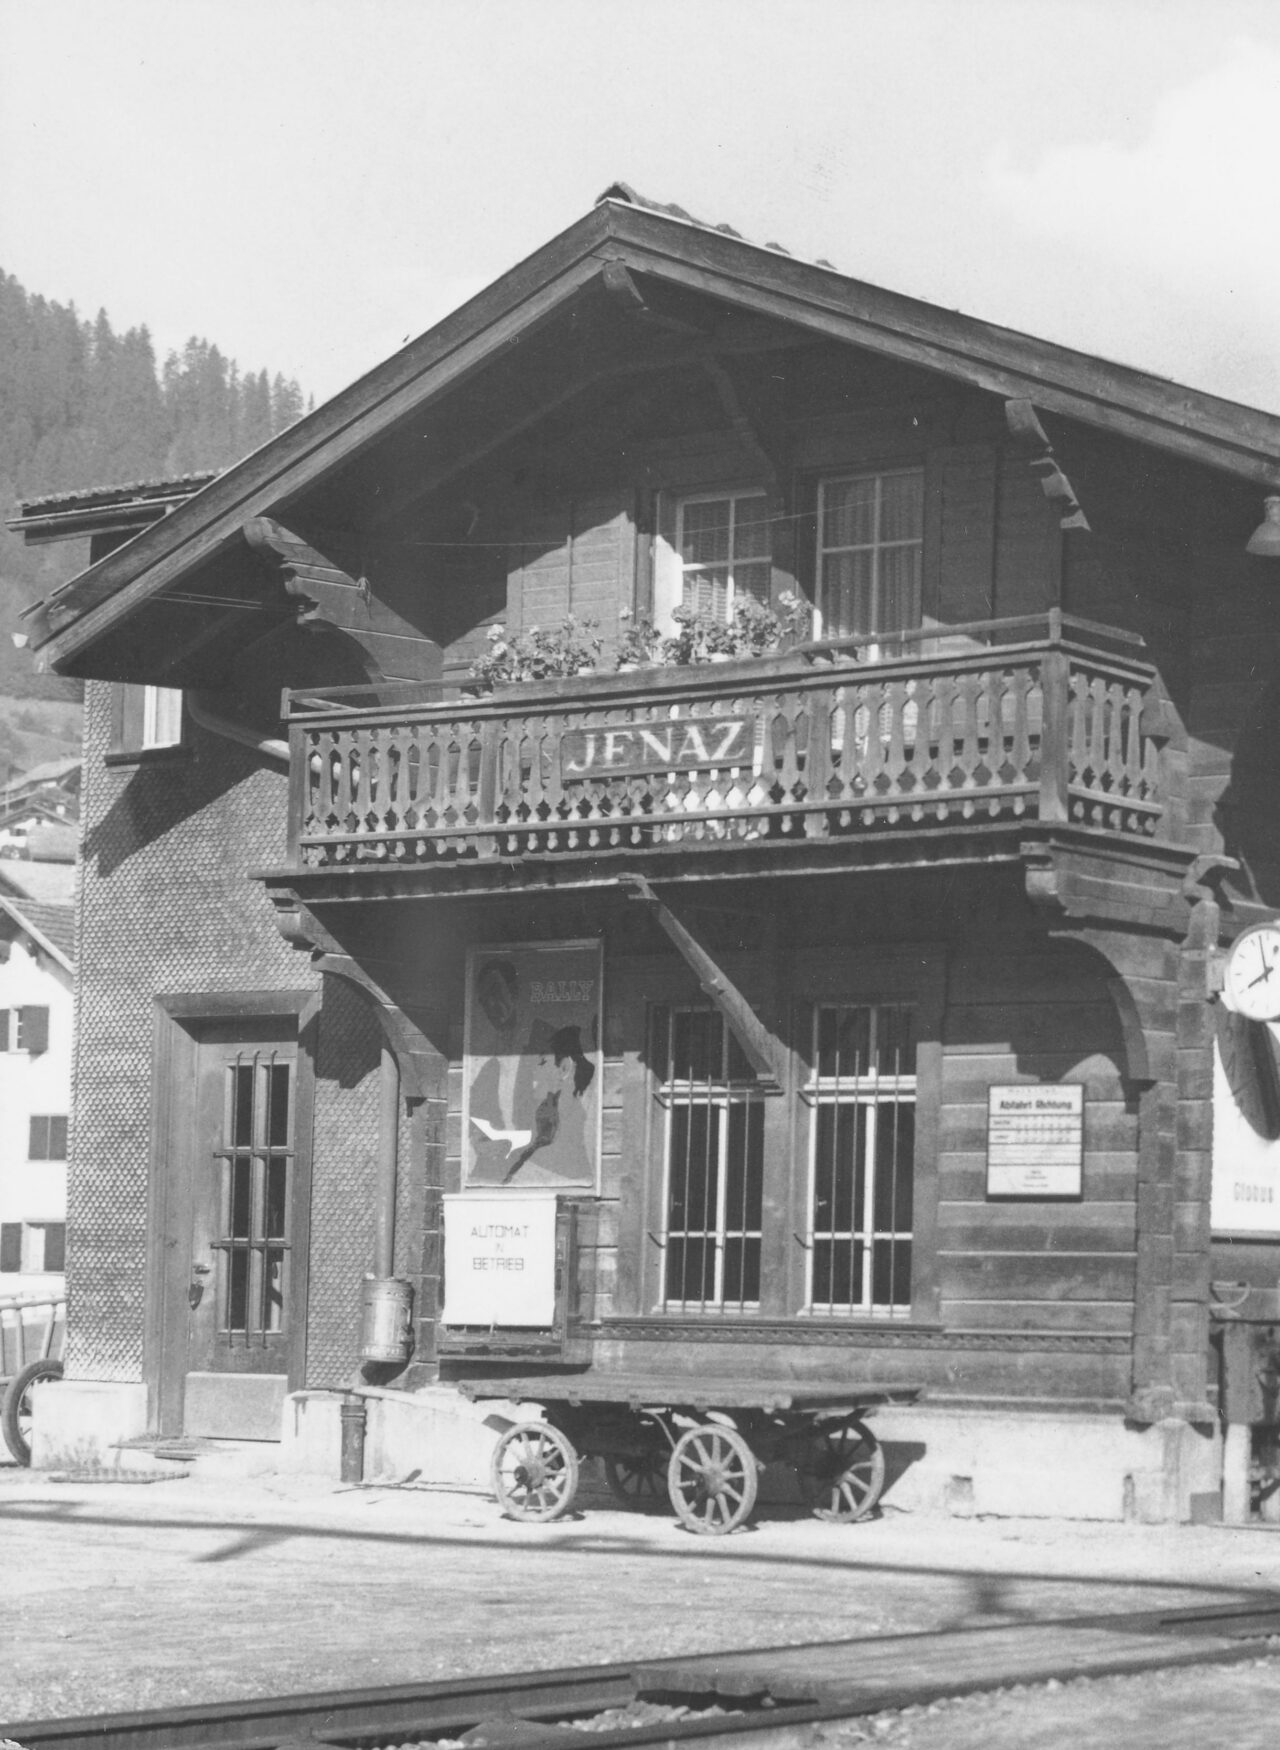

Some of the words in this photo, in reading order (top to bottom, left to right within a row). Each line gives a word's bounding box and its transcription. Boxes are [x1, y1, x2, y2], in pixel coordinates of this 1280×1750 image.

[566, 721, 745, 772] JENAZ
[530, 980, 594, 1002] BALLY
[1233, 1181, 1274, 1204] Globus
[471, 1224, 529, 1239] AUTOMAT
[472, 1256, 525, 1271] BETRIEB
